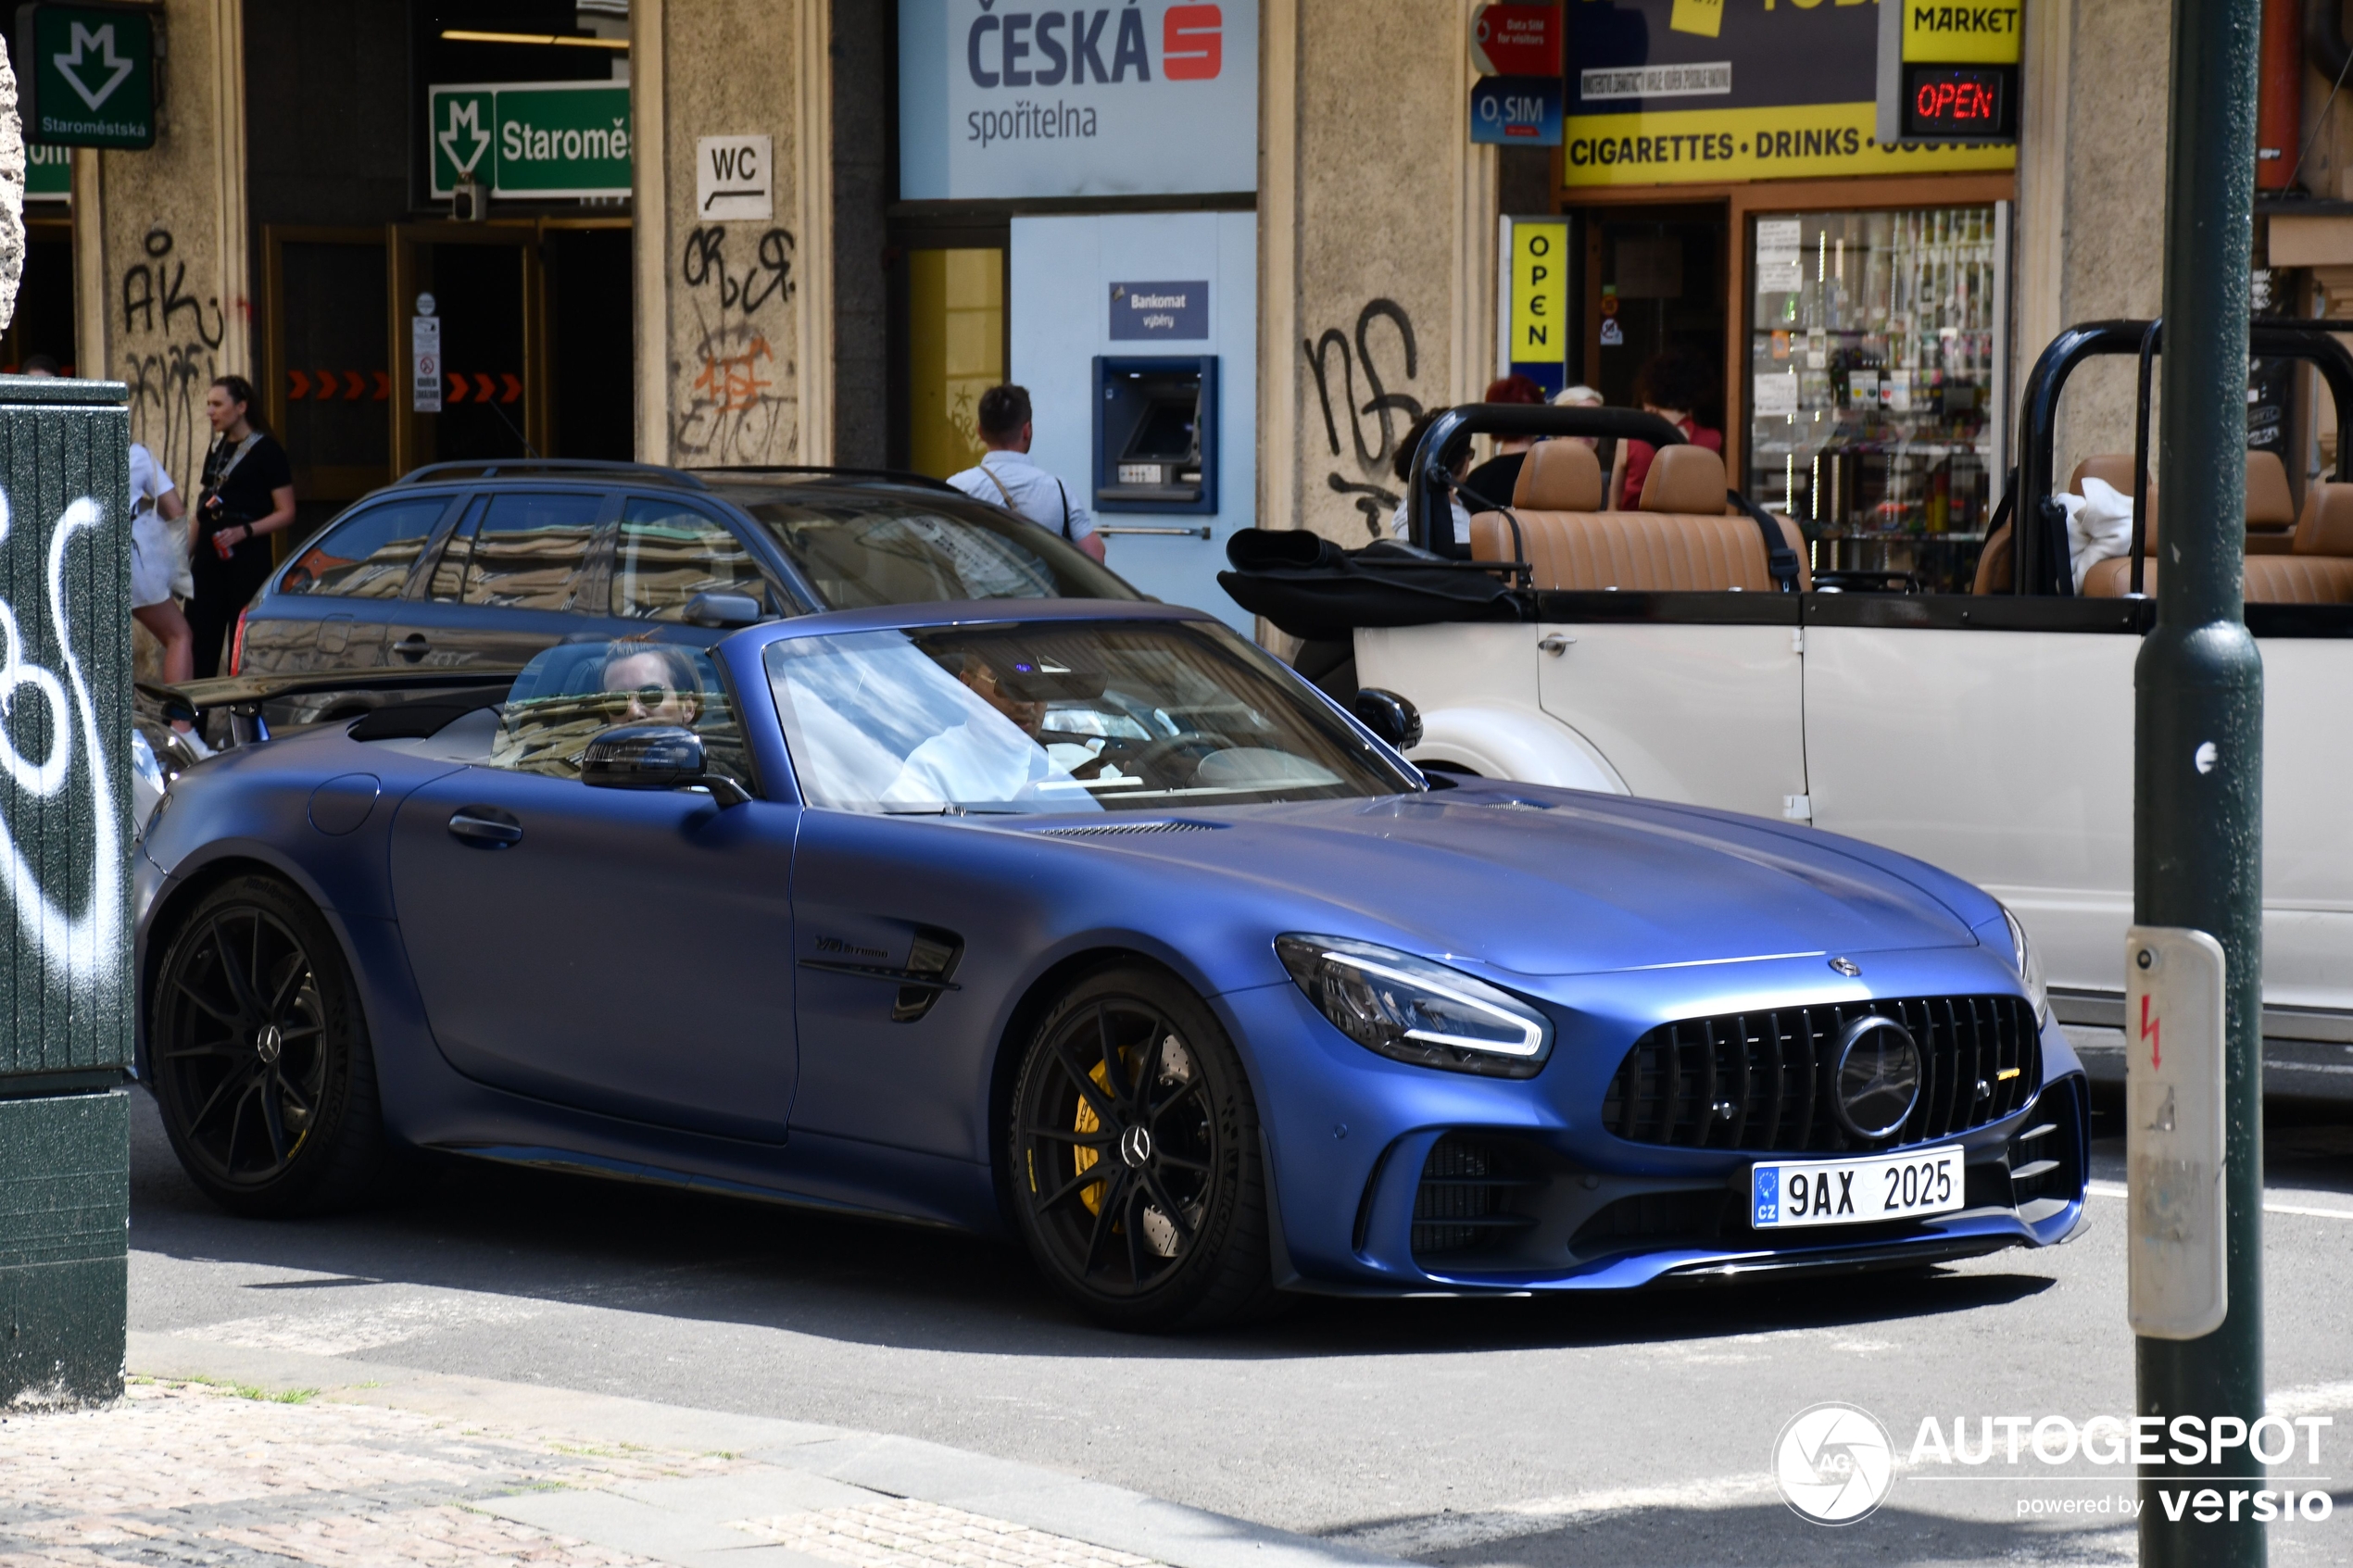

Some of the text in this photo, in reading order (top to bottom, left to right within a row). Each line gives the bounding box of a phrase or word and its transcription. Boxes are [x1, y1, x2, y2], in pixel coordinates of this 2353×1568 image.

[1914, 6, 2018, 32] MARKET
[967, 0, 1151, 89] ČESKÁ
[1504, 96, 1543, 122] SIM
[1918, 82, 1994, 119] OPEN
[43, 117, 146, 137] Staroměstská
[502, 118, 633, 161] Staromě
[968, 100, 1097, 148] spořitelna
[711, 146, 757, 181] WC
[1570, 127, 1859, 166] CIGARETTES DRINKS
[1131, 294, 1186, 309] Bankomat
[1529, 235, 1549, 345] OPEN
[1143, 313, 1174, 329] výběry
[1758, 1160, 1951, 1220] CZ 9AX 2025
